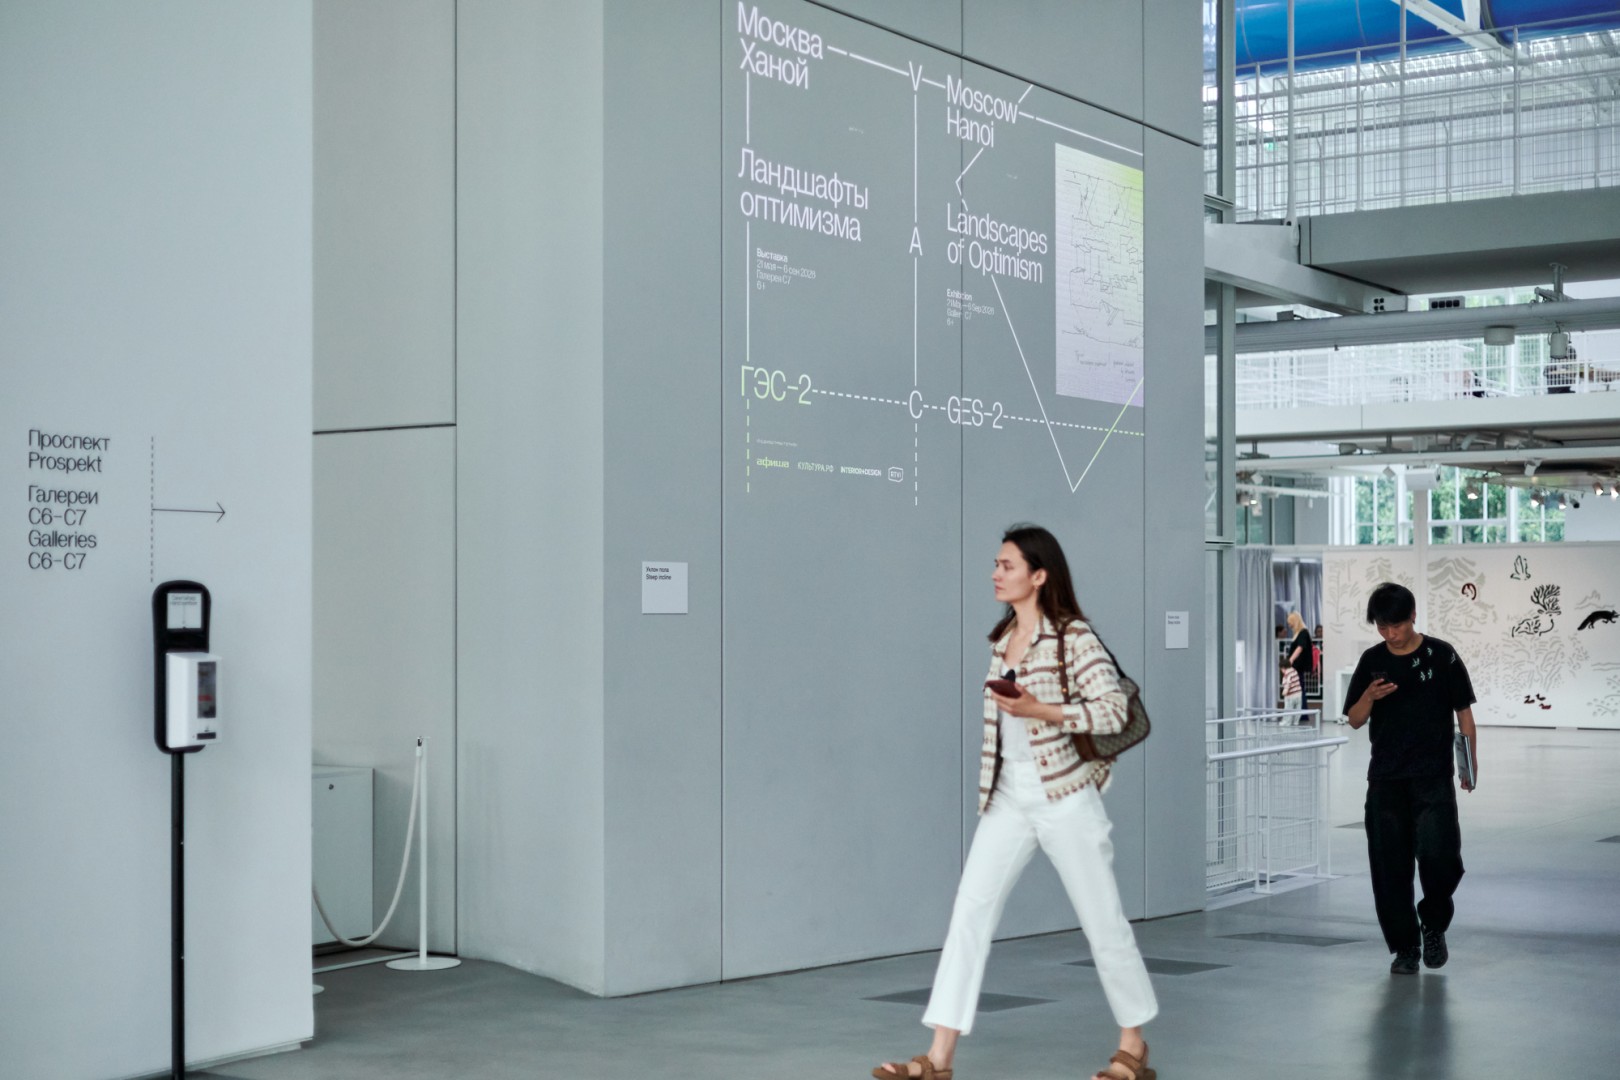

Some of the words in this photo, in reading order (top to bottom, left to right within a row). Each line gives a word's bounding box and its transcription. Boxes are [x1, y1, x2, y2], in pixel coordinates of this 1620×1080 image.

[738, 0, 823, 60] Москва
[740, 37, 808, 90] Ханой
[908, 61, 922, 91] V
[947, 74, 1018, 124] Moscow
[947, 106, 994, 148] Hanoi
[738, 147, 868, 210] Ландшафты
[740, 191, 862, 242] оптимизма
[947, 202, 1048, 254] Landscapes
[756, 247, 788, 263] Выставка
[909, 226, 923, 256] A
[947, 238, 965, 265] of
[968, 241, 1043, 284] Optimism
[946, 288, 973, 301] Exhibtion
[741, 365, 812, 405] ГЭС-2
[908, 390, 923, 419] C
[947, 396, 1003, 429] GES-2
[28, 429, 111, 451] Проспект
[28, 451, 103, 474] Prospekt
[756, 457, 790, 469] афиша
[28, 484, 99, 507] Галереи
[28, 529, 98, 549] Galleries
